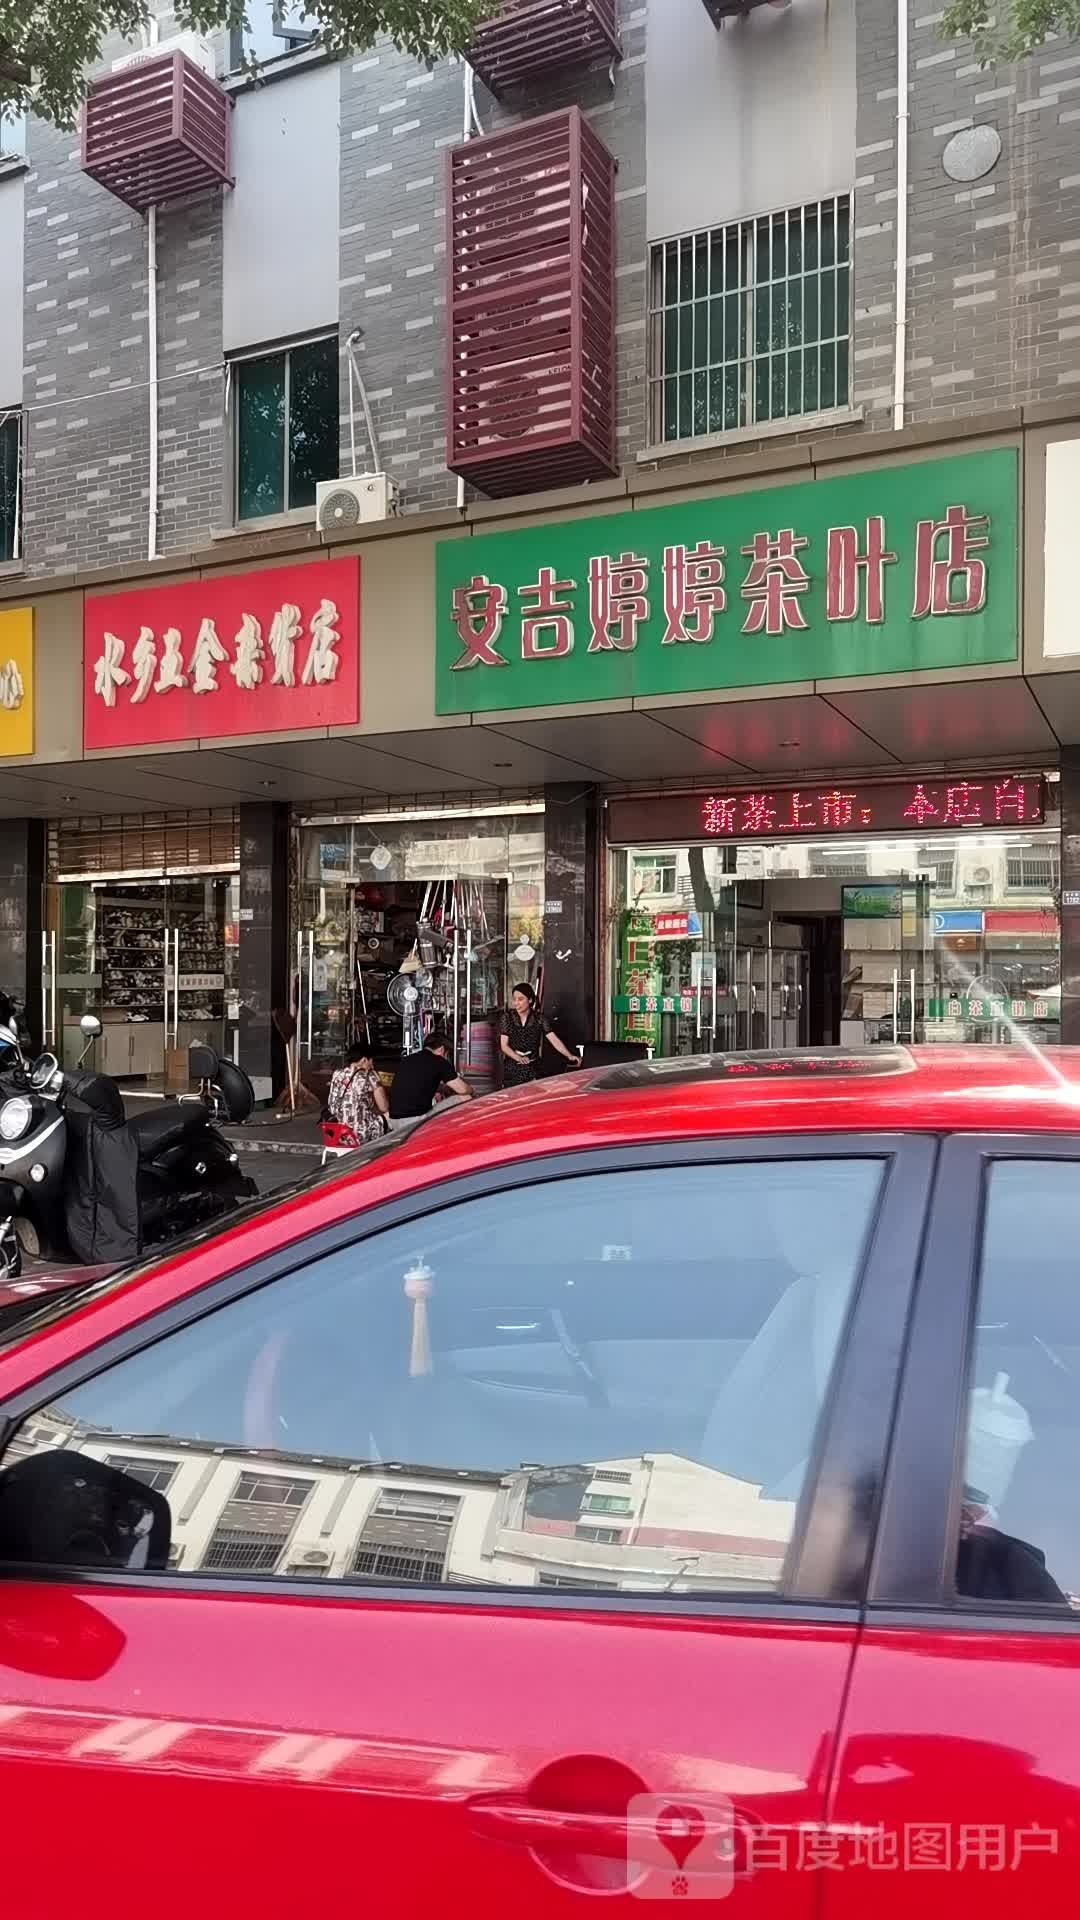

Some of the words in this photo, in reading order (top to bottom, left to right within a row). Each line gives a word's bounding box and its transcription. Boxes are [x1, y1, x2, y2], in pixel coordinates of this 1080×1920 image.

[450, 505, 993, 671] 安吉婷婷茶叶店
